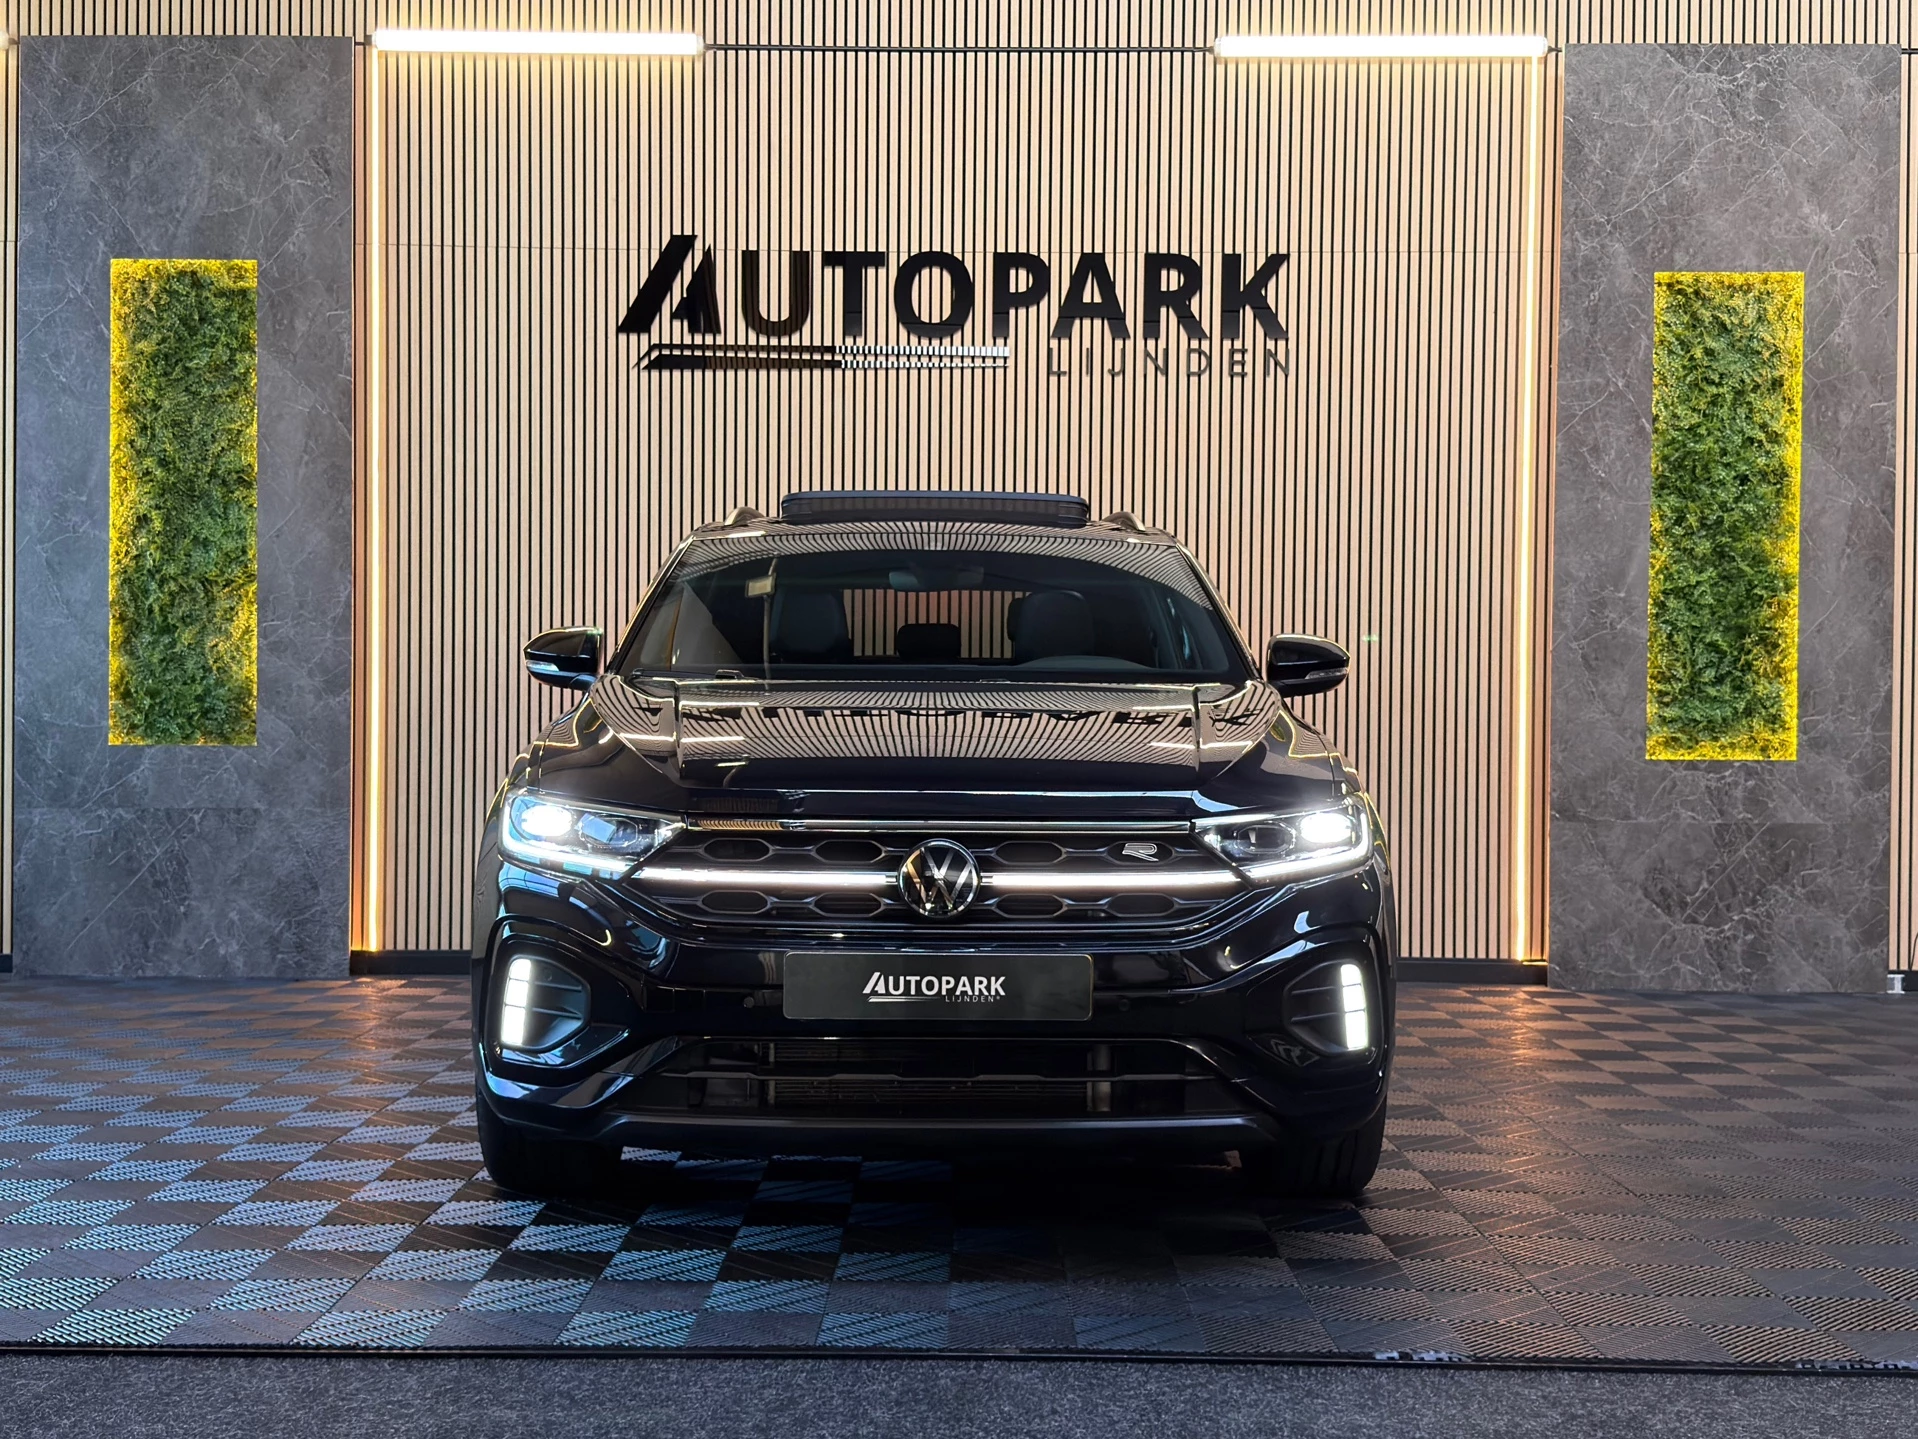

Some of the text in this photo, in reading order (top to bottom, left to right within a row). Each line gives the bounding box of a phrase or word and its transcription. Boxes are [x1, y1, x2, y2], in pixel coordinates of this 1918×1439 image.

[617, 234, 1291, 340] AUTOPARK
[1048, 347, 1291, 378] LIJNDEN
[862, 972, 1006, 996] AUTOPARK
